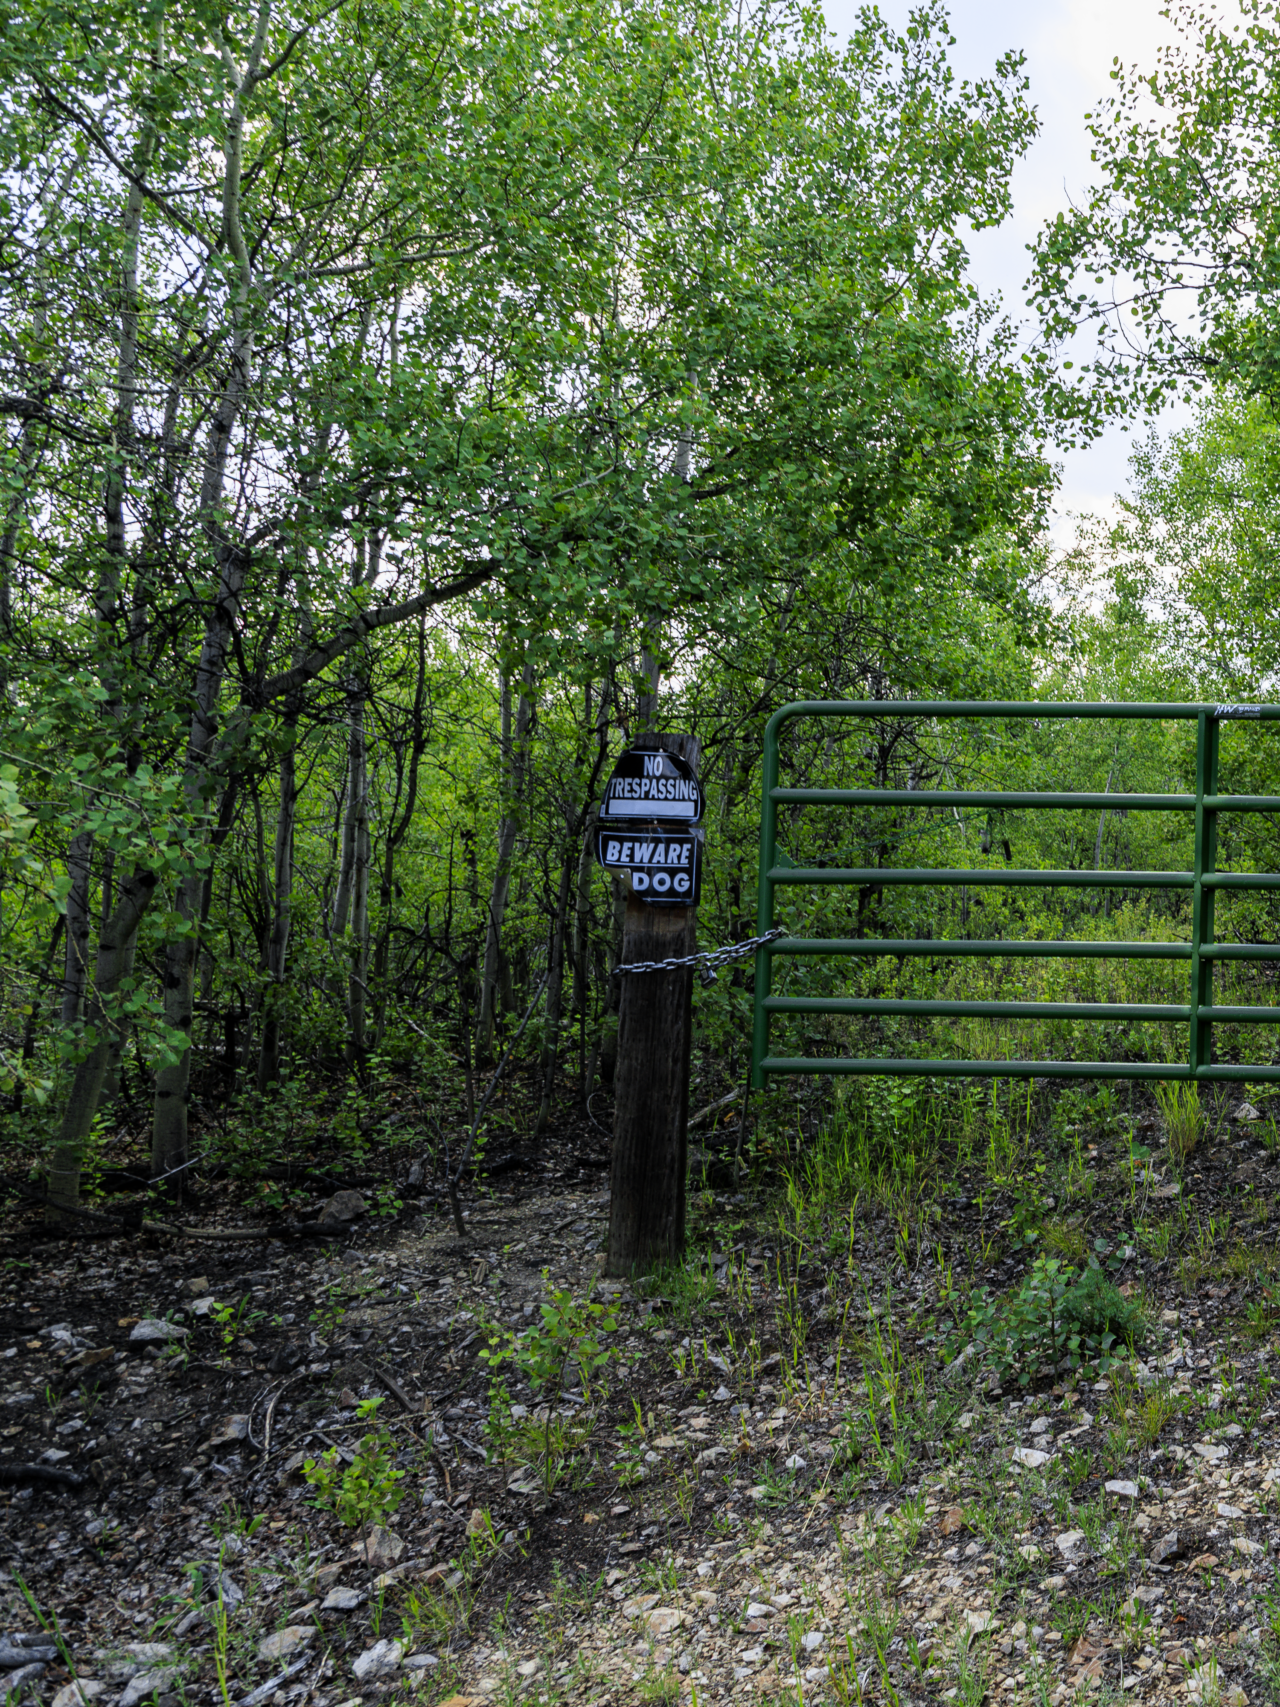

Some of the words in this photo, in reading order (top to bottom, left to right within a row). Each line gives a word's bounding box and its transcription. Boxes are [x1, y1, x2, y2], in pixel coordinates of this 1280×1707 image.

[644, 755, 663, 777] NO
[610, 777, 698, 800] TRESPASSING
[606, 840, 692, 865] BEWARE
[632, 871, 691, 893] DOG
